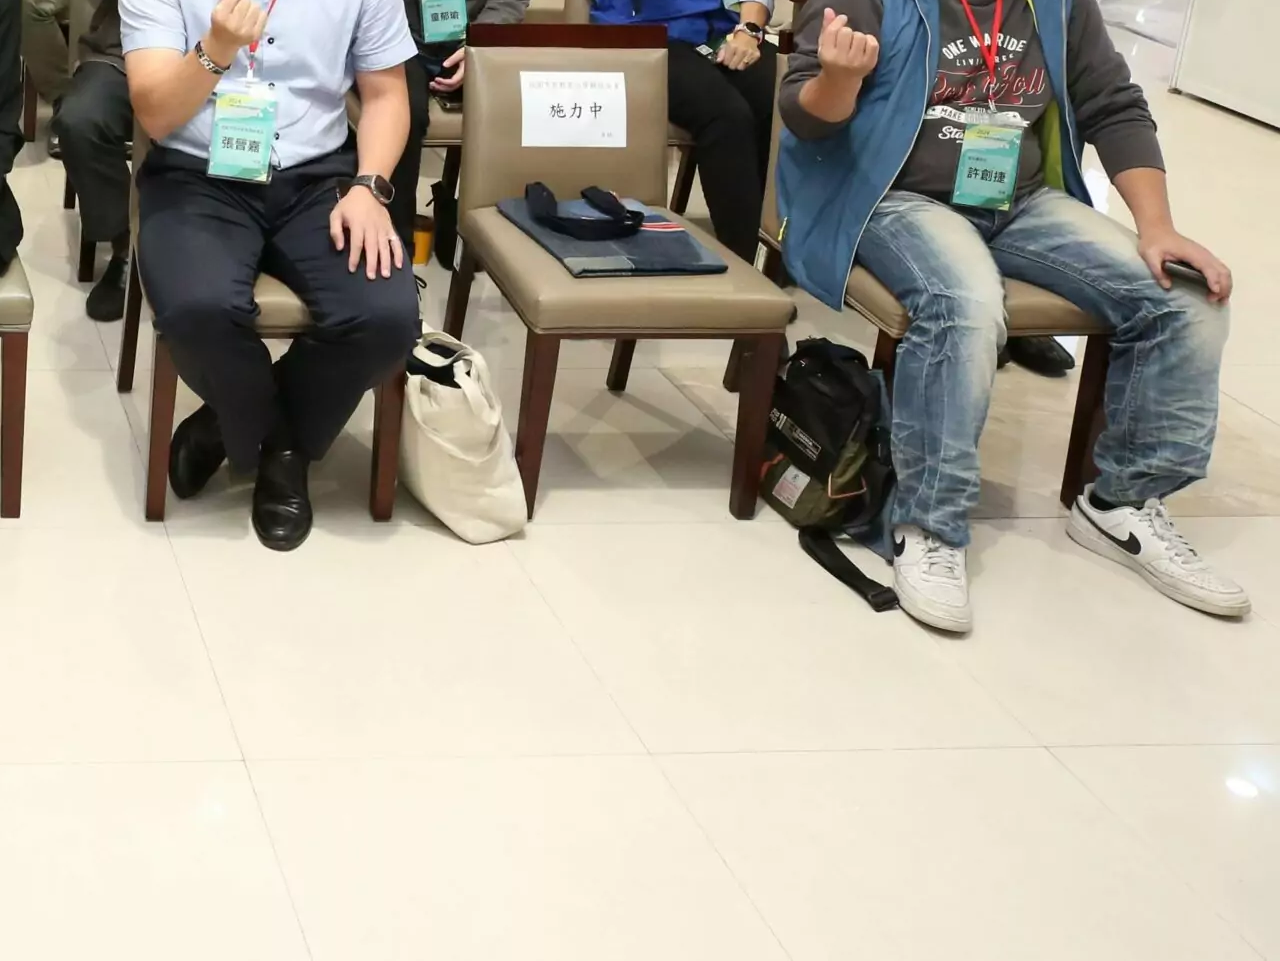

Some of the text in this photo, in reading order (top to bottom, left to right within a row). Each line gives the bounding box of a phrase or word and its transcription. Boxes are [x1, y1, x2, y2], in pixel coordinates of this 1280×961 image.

[942, 39, 967, 60] ONE
[549, 102, 602, 119] 施力中
[940, 106, 962, 121] MAKE
[967, 166, 1006, 183] 許創捷
